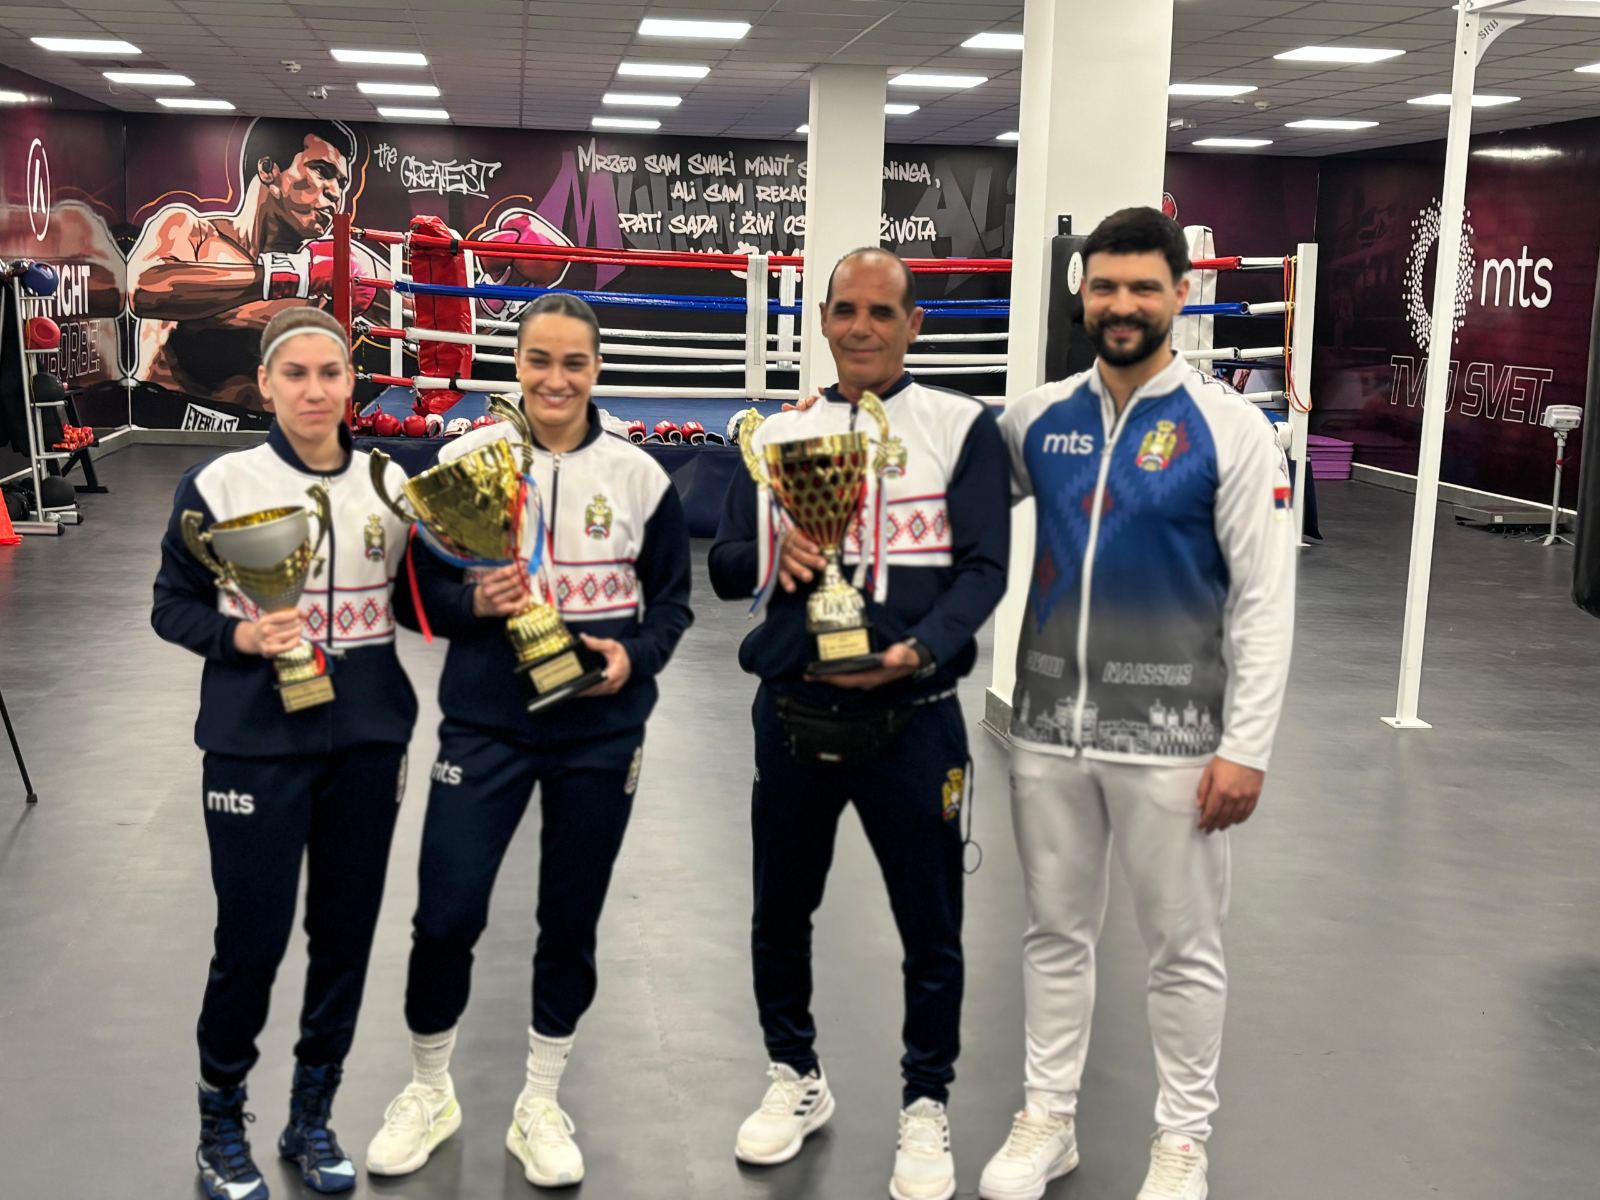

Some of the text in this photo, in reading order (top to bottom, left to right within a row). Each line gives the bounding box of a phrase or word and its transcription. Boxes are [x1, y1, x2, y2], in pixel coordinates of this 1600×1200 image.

[400, 155, 502, 197] GREATEST
[703, 182, 744, 205] SAM
[1480, 245, 1554, 309] mts
[1042, 430, 1094, 455] mts
[207, 789, 255, 815] mts
